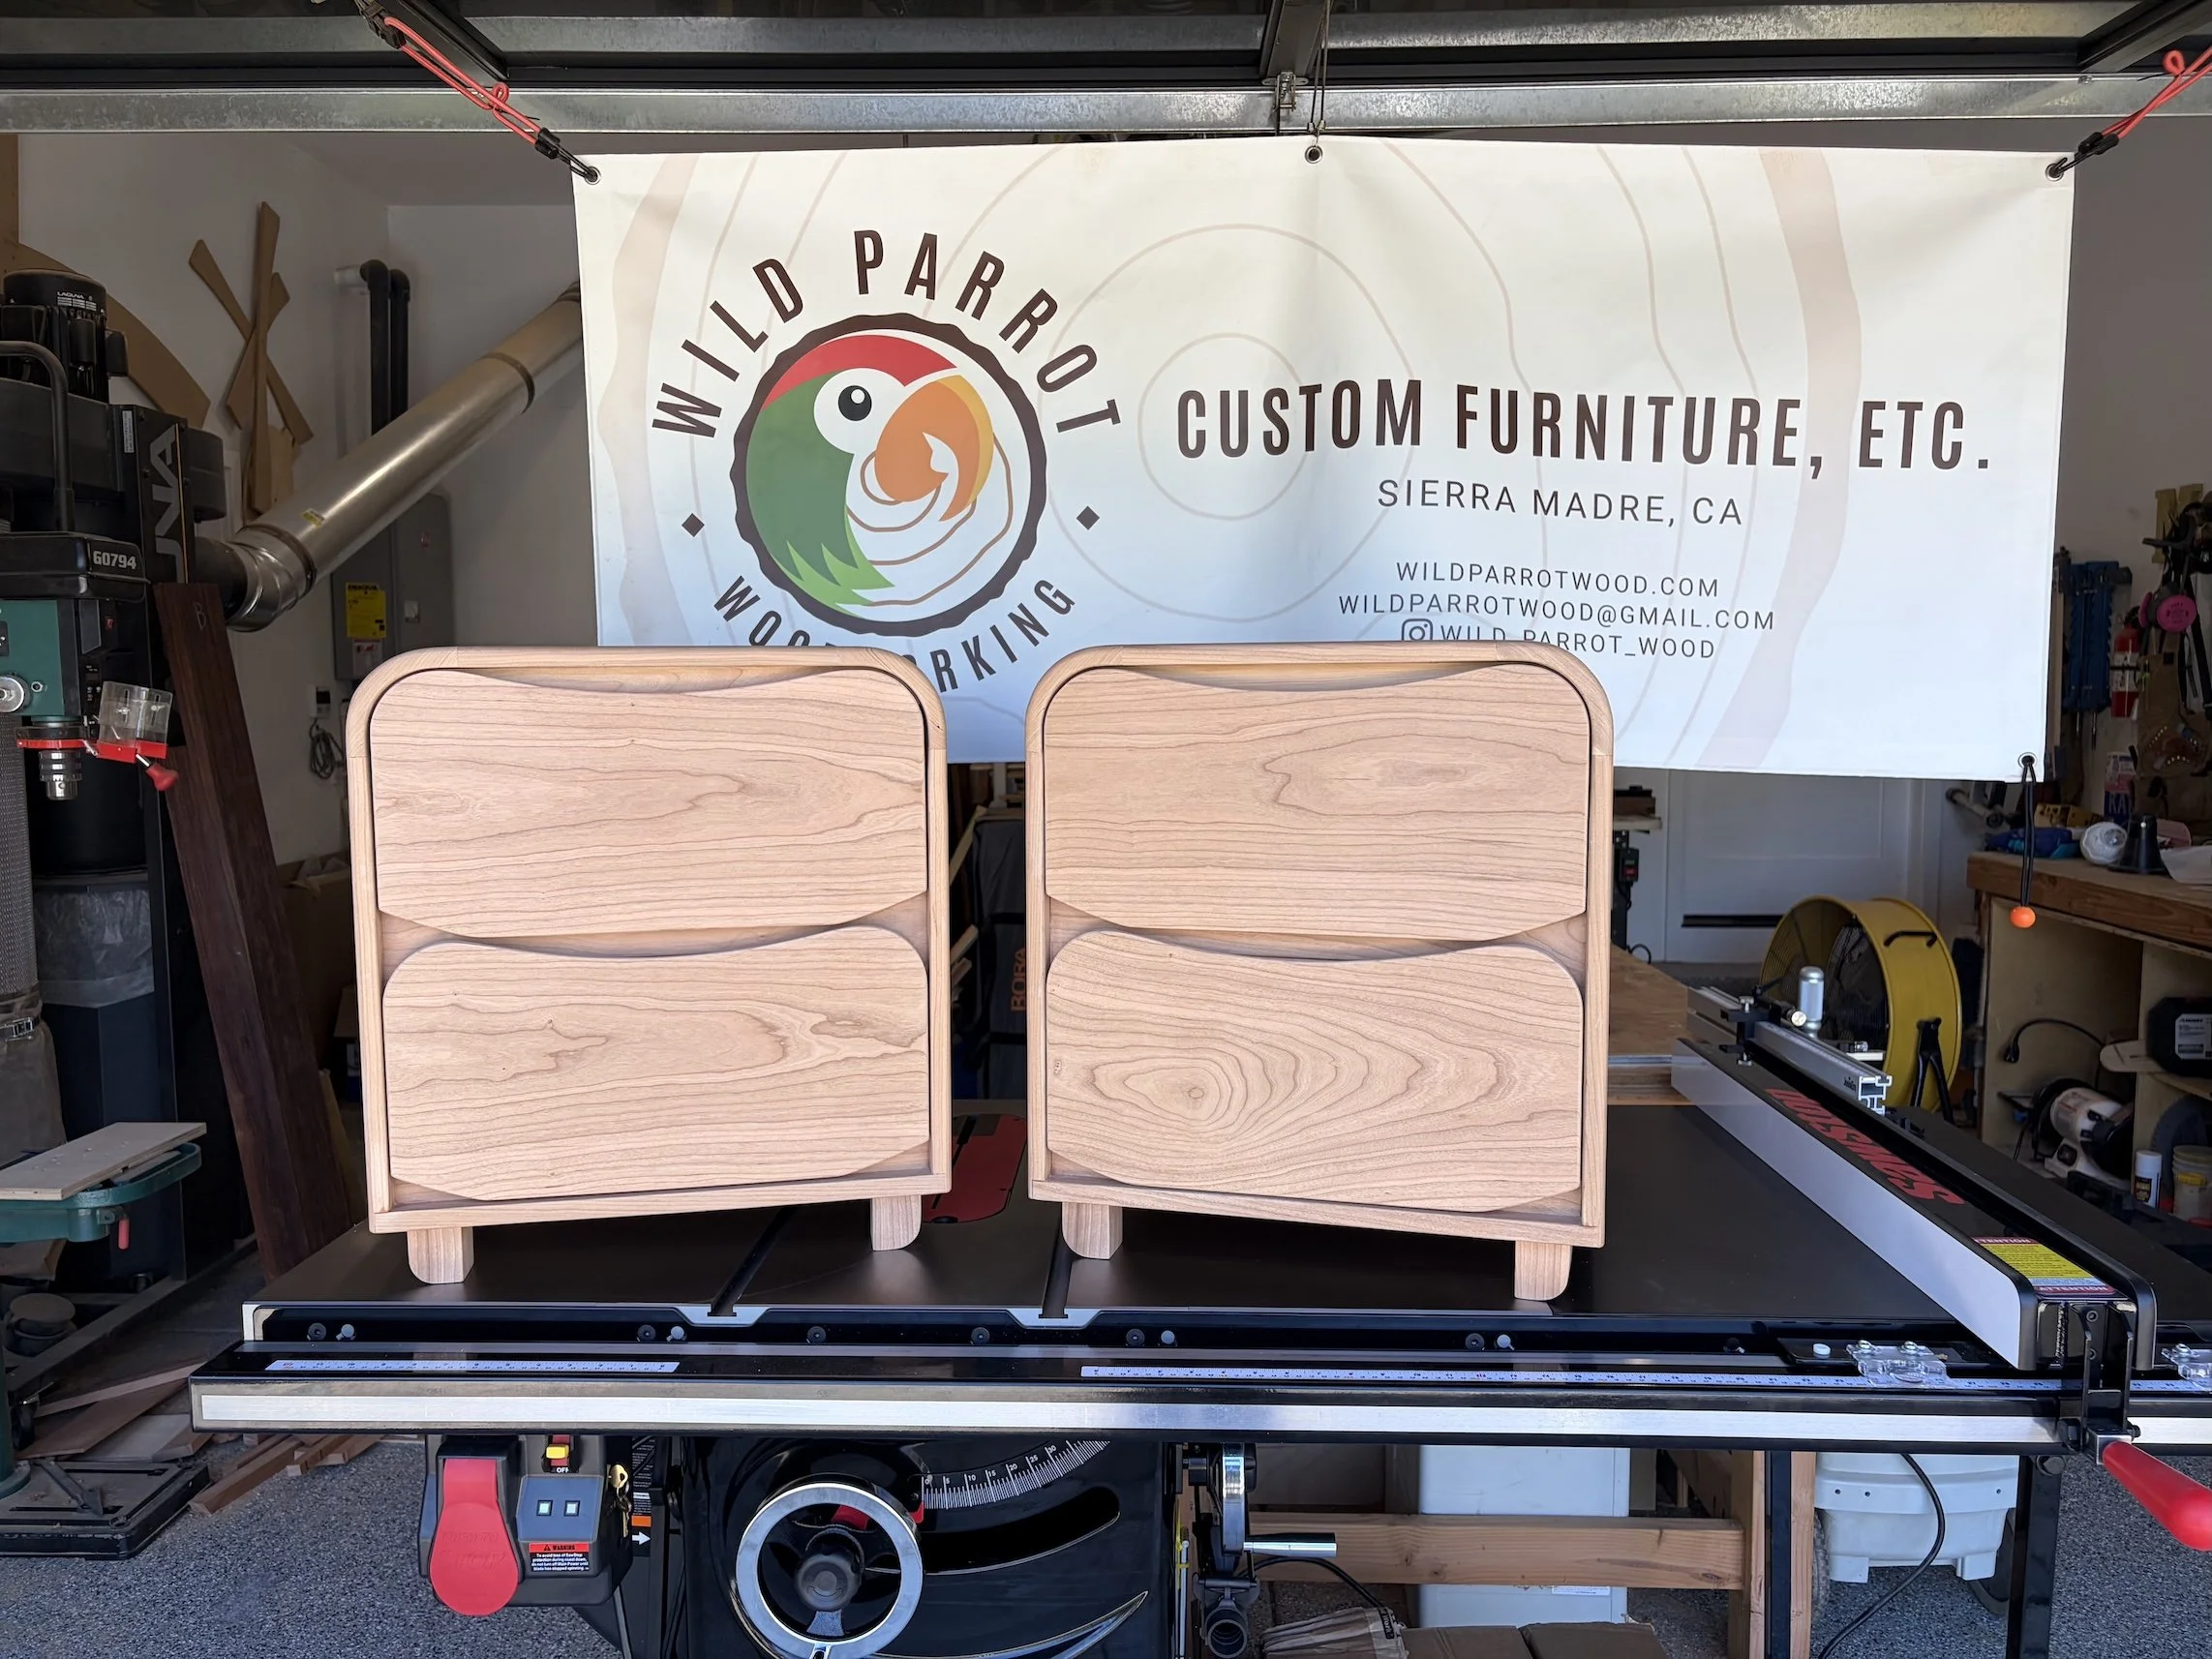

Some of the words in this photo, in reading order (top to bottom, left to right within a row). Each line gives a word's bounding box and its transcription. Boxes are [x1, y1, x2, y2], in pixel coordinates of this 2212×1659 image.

[651, 257, 803, 438] WILD
[854, 229, 1121, 433] PARROT
[1177, 378, 1421, 459] CUSTOM
[1457, 384, 1823, 480] FURNITURE,
[1858, 400, 1988, 470] ETC.
[1378, 479, 1516, 513] SIERRA
[1532, 489, 1675, 528] MADRE,
[1692, 498, 1742, 526] CA
[1396, 561, 1718, 597] WILDPARROTWOOD.COM
[1340, 593, 1773, 630] WILDPARROTWOOD@GMAIL.COM
[713, 575, 1076, 692] WORKING
[1440, 625, 1714, 659] WILDPARROT_WOOD
[987, 1469, 996, 1478] 15
[1029, 1455, 1039, 1463] 25
[1047, 1445, 1057, 1454] 30
